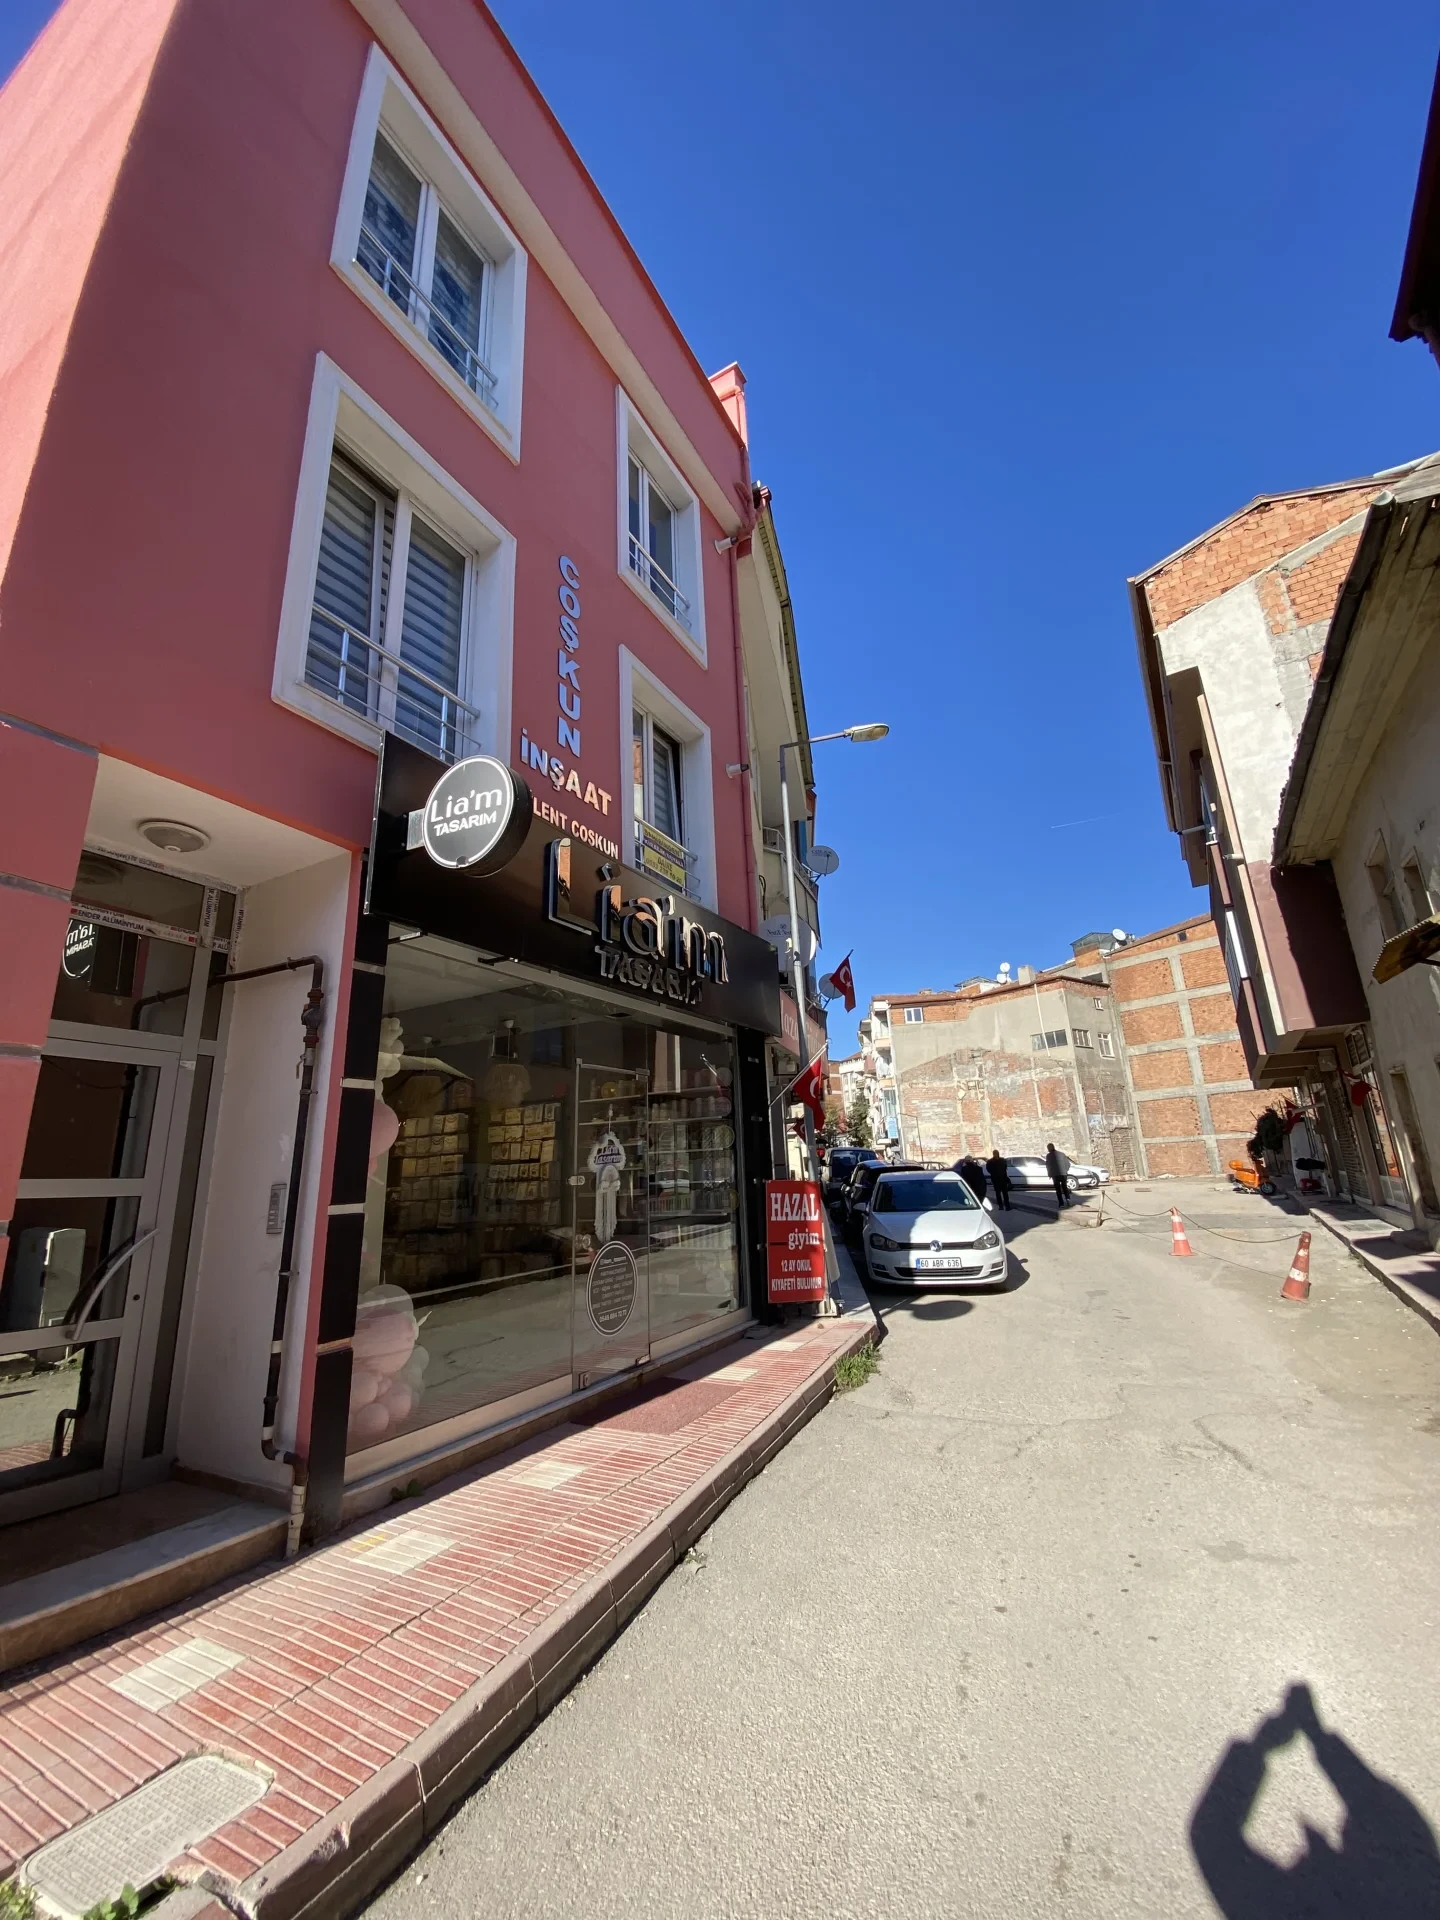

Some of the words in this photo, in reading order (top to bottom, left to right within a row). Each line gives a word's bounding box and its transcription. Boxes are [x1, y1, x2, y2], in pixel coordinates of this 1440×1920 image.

[519, 727, 612, 817] İNŞAAT
[433, 810, 497, 836] TASARIM
[77, 909, 101, 921] ENDER
[770, 1192, 819, 1222] HAZAL
[788, 1228, 820, 1250] giyim
[781, 1260, 788, 1272] 12
[789, 1260, 796, 1272] AY
[797, 1259, 812, 1271] OKUL
[921, 1260, 929, 1268] 60
[933, 1260, 944, 1268] ABR
[772, 1275, 796, 1291] KIYAFETİ
